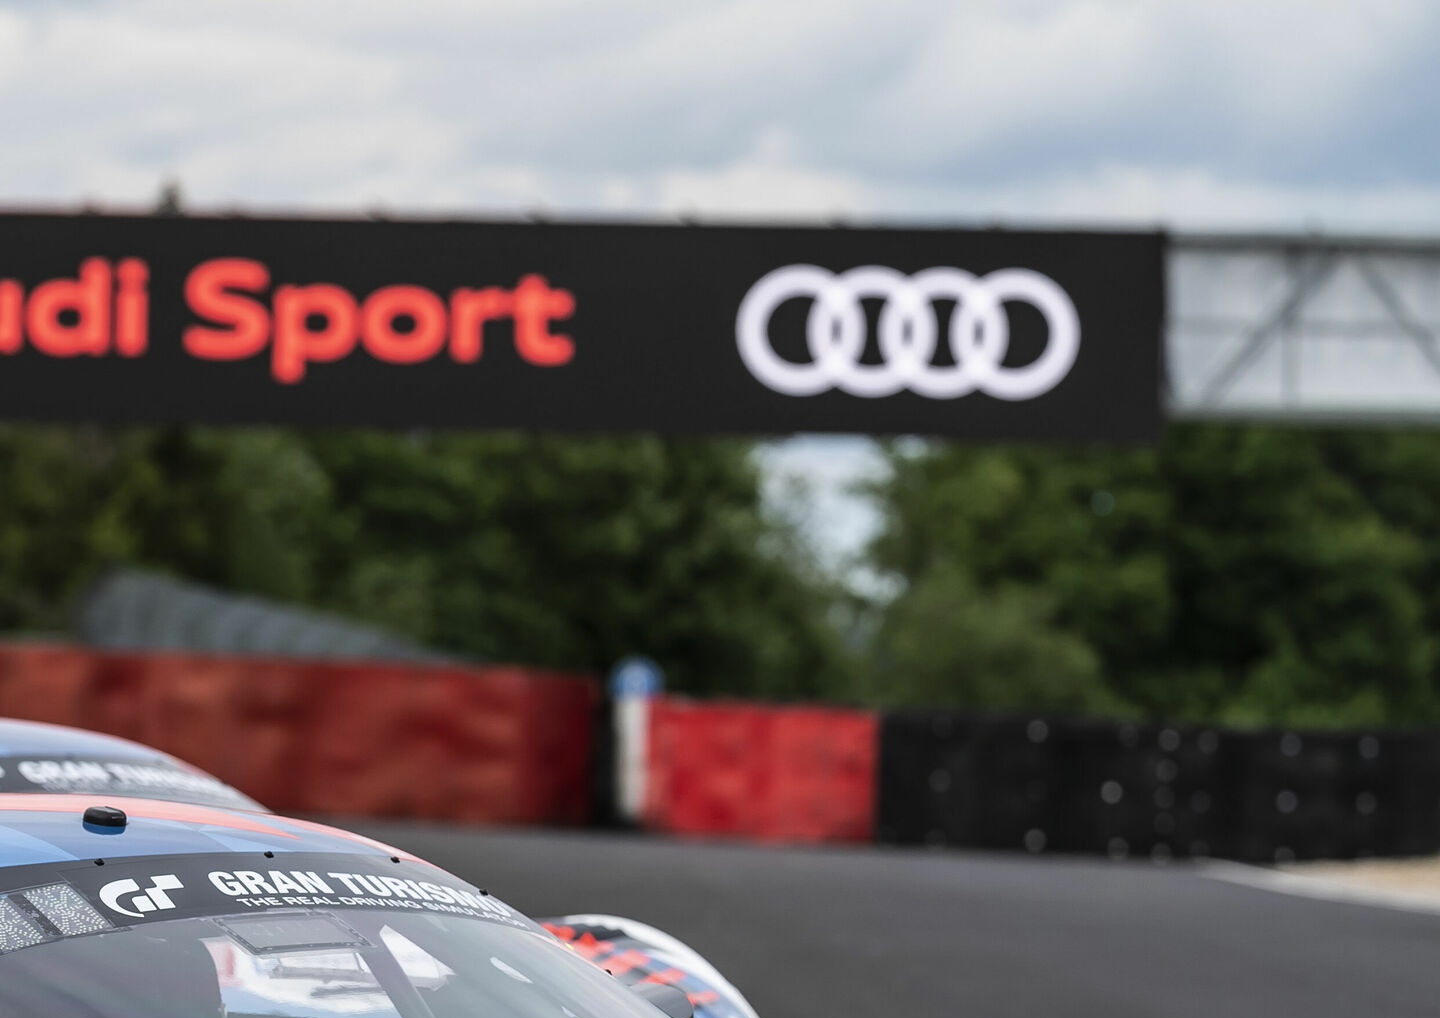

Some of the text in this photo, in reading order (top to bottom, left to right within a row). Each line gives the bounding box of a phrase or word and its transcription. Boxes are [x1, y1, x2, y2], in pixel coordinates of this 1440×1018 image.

[182, 256, 576, 384] Sport
[207, 869, 335, 897] GRAN
[236, 897, 284, 908] THE
[282, 896, 340, 906] REAL
[338, 896, 424, 910] DRIVING
